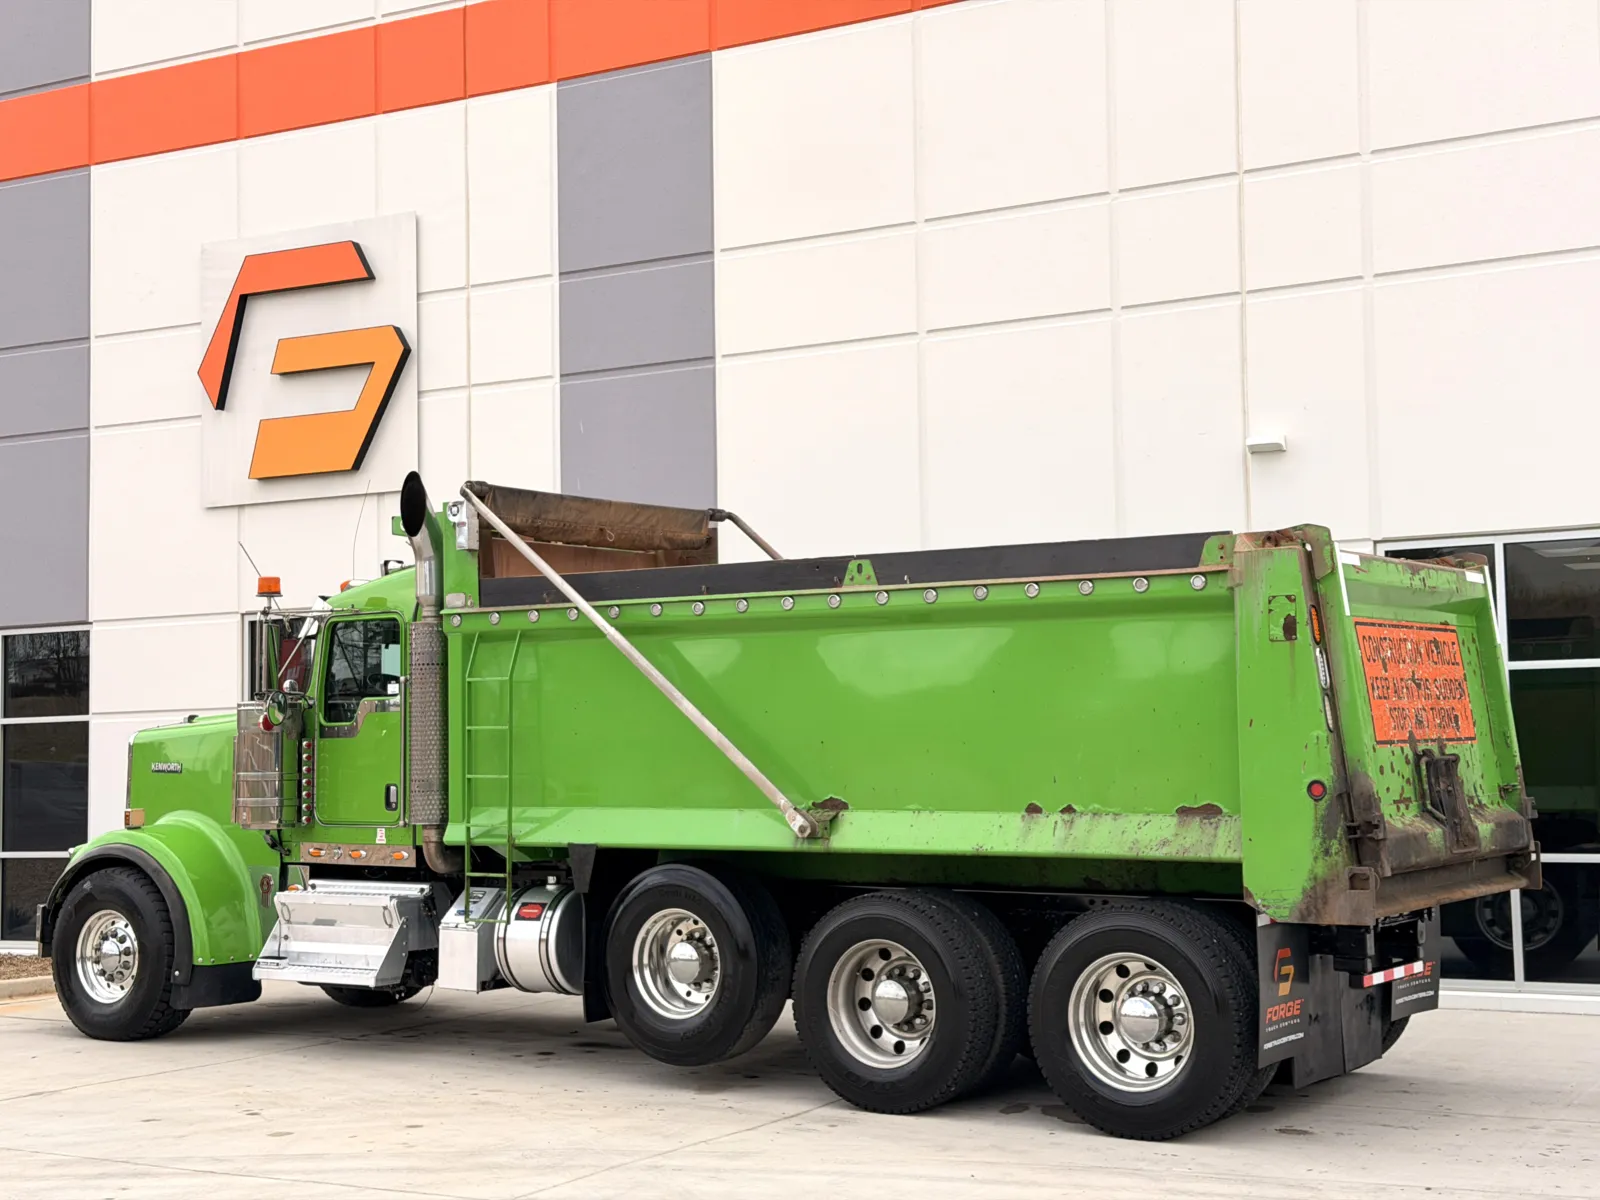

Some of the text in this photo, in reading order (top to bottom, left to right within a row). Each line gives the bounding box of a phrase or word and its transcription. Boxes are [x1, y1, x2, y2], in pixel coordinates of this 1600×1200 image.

[1362, 635, 1460, 667] CONSTRUCTION VEHICLE
[1369, 676, 1391, 700] KEEP
[1433, 678, 1467, 701] SUDDEN
[1389, 706, 1412, 731] STOPS
[151, 762, 181, 773] KENWORTH
[1265, 1000, 1301, 1024] FORGE
